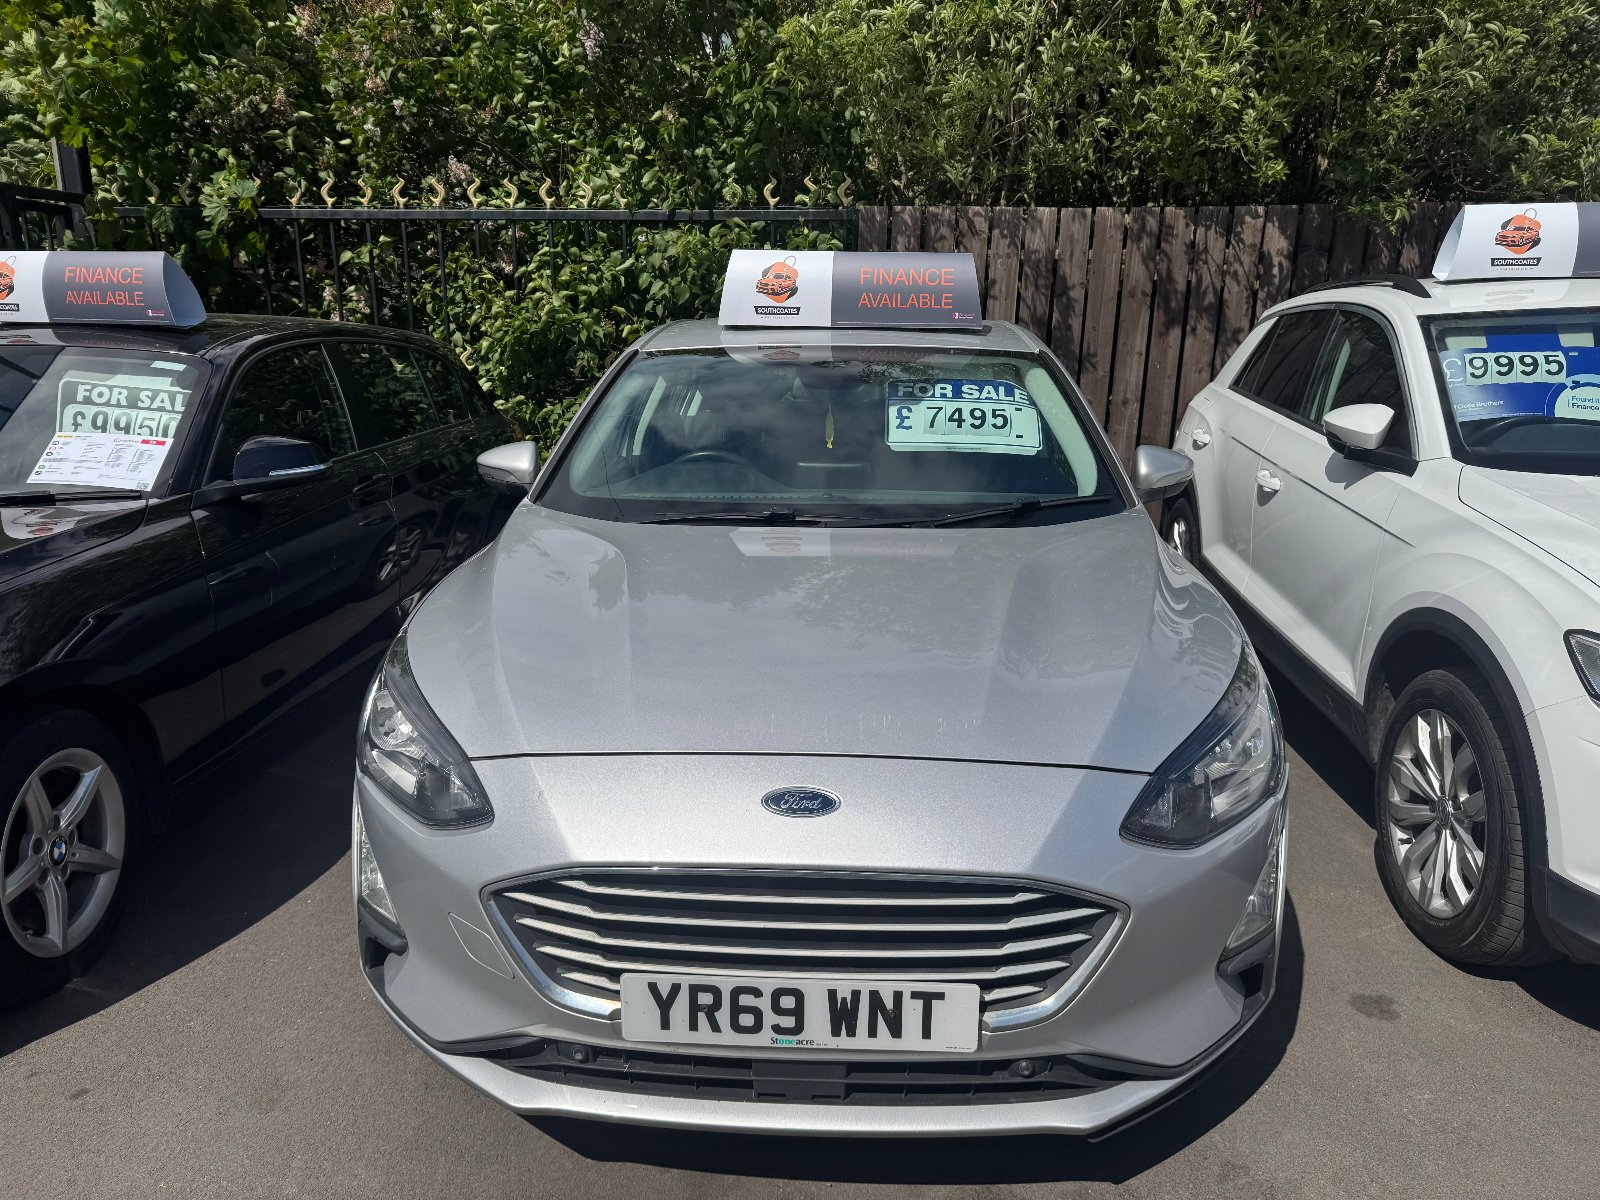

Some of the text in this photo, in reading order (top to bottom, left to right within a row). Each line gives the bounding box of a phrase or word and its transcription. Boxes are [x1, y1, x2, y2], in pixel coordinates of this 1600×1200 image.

[1493, 258, 1538, 266] SOUTHCOATES
[64, 267, 144, 284] FINANCE
[859, 268, 955, 286] FINANCE
[65, 291, 145, 306] AVAILABLE
[858, 293, 953, 308] AVAILABLE
[76, 384, 187, 412] FOR SAL
[897, 382, 1029, 404] FOR SALE
[1571, 403, 1600, 411] Finance
[926, 406, 1009, 430] 7495
[780, 793, 822, 809] Ford
[647, 982, 946, 1040] YR69 WNT
[770, 1036, 815, 1047] Stoneacre
